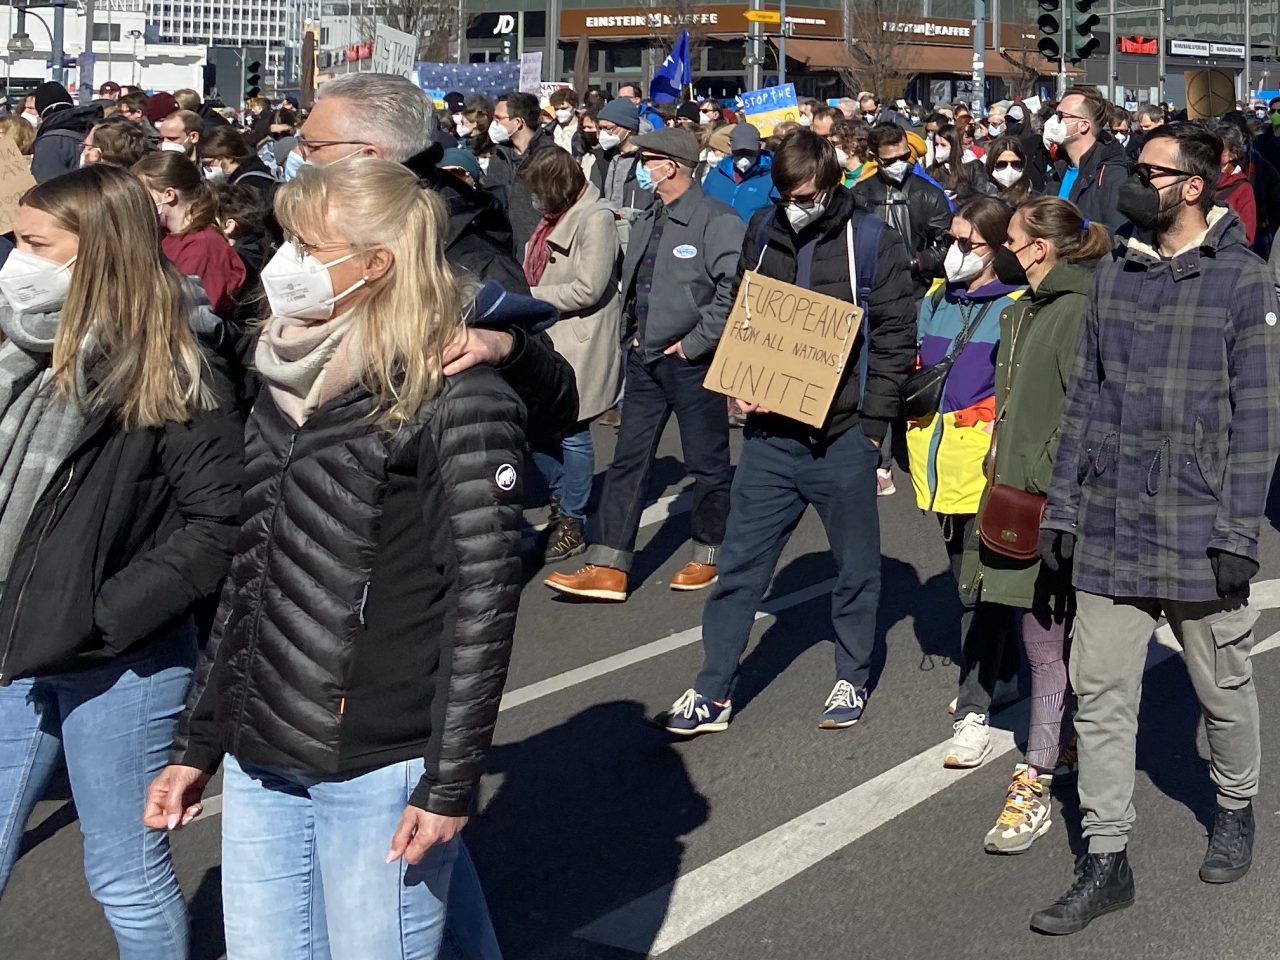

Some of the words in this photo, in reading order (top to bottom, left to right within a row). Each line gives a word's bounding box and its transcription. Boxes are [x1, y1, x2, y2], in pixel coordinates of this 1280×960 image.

[493, 14, 515, 35] JD
[585, 16, 646, 28] EINSTEIN
[935, 25, 970, 37] KAFFEE
[745, 93, 769, 108] STOP
[740, 281, 858, 341] EUROPEANS
[730, 320, 759, 344] FROM
[761, 330, 784, 352] ALL
[792, 342, 840, 367] NATIONS
[719, 356, 825, 417] UNITE
